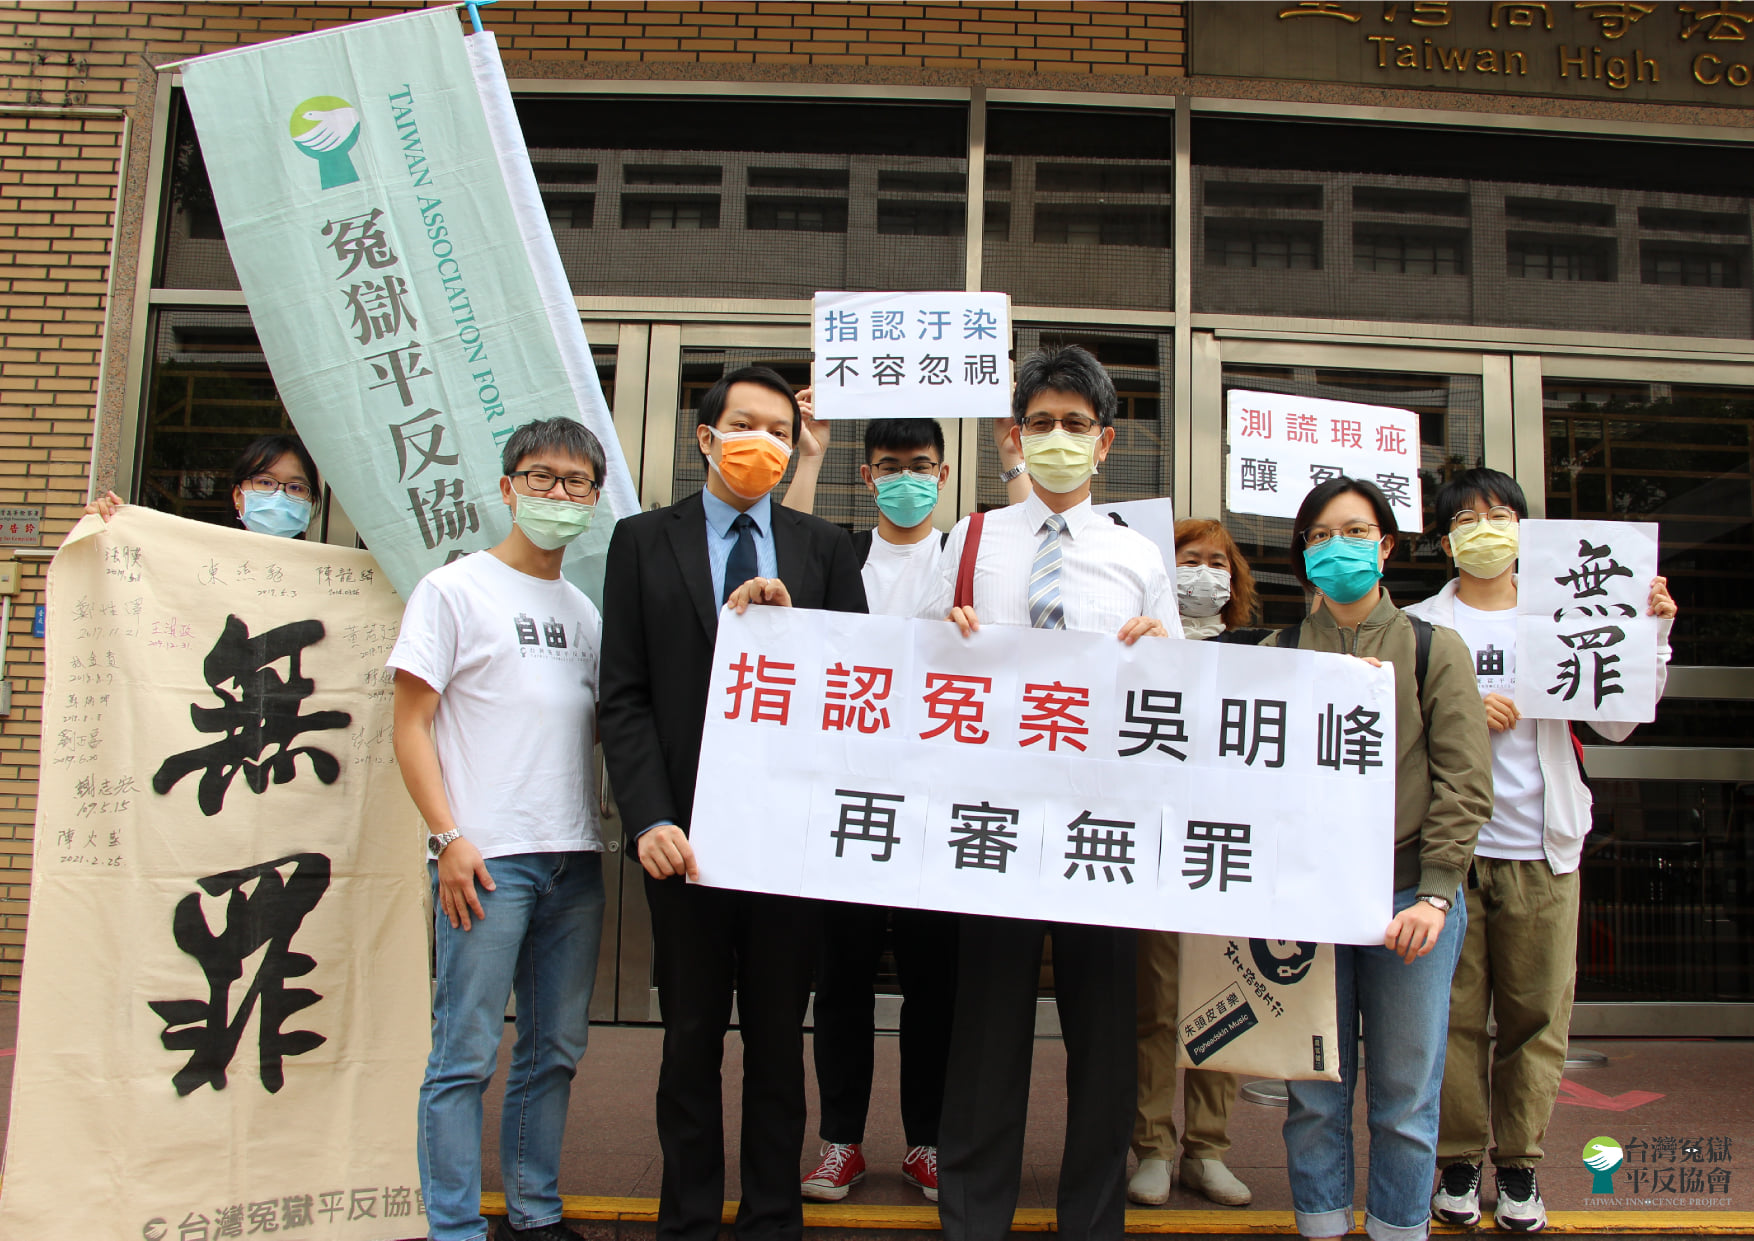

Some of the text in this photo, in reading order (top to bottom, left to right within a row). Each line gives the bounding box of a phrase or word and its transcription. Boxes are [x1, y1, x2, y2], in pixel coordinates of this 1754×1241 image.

[1368, 35, 1753, 90] Taiwan High Co
[388, 83, 433, 188] TAIWAN
[416, 194, 487, 364] ASSOCIATION
[472, 368, 505, 423] FOR
[321, 207, 480, 565] 冤獄平反協
[825, 353, 1000, 387] 不容忽視
[1240, 408, 1407, 455] 測謊瑕疵
[0, 523, 35, 534] 告鈴
[1546, 539, 1637, 711] 無罪
[724, 652, 1384, 775] 指認冤案吳明峰
[147, 613, 352, 1097] 無罪
[830, 788, 1253, 892] 再審無罪
[1184, 991, 1240, 1038] 朱頭皮音樂
[1193, 1013, 1249, 1056] Pigheadskin Music
